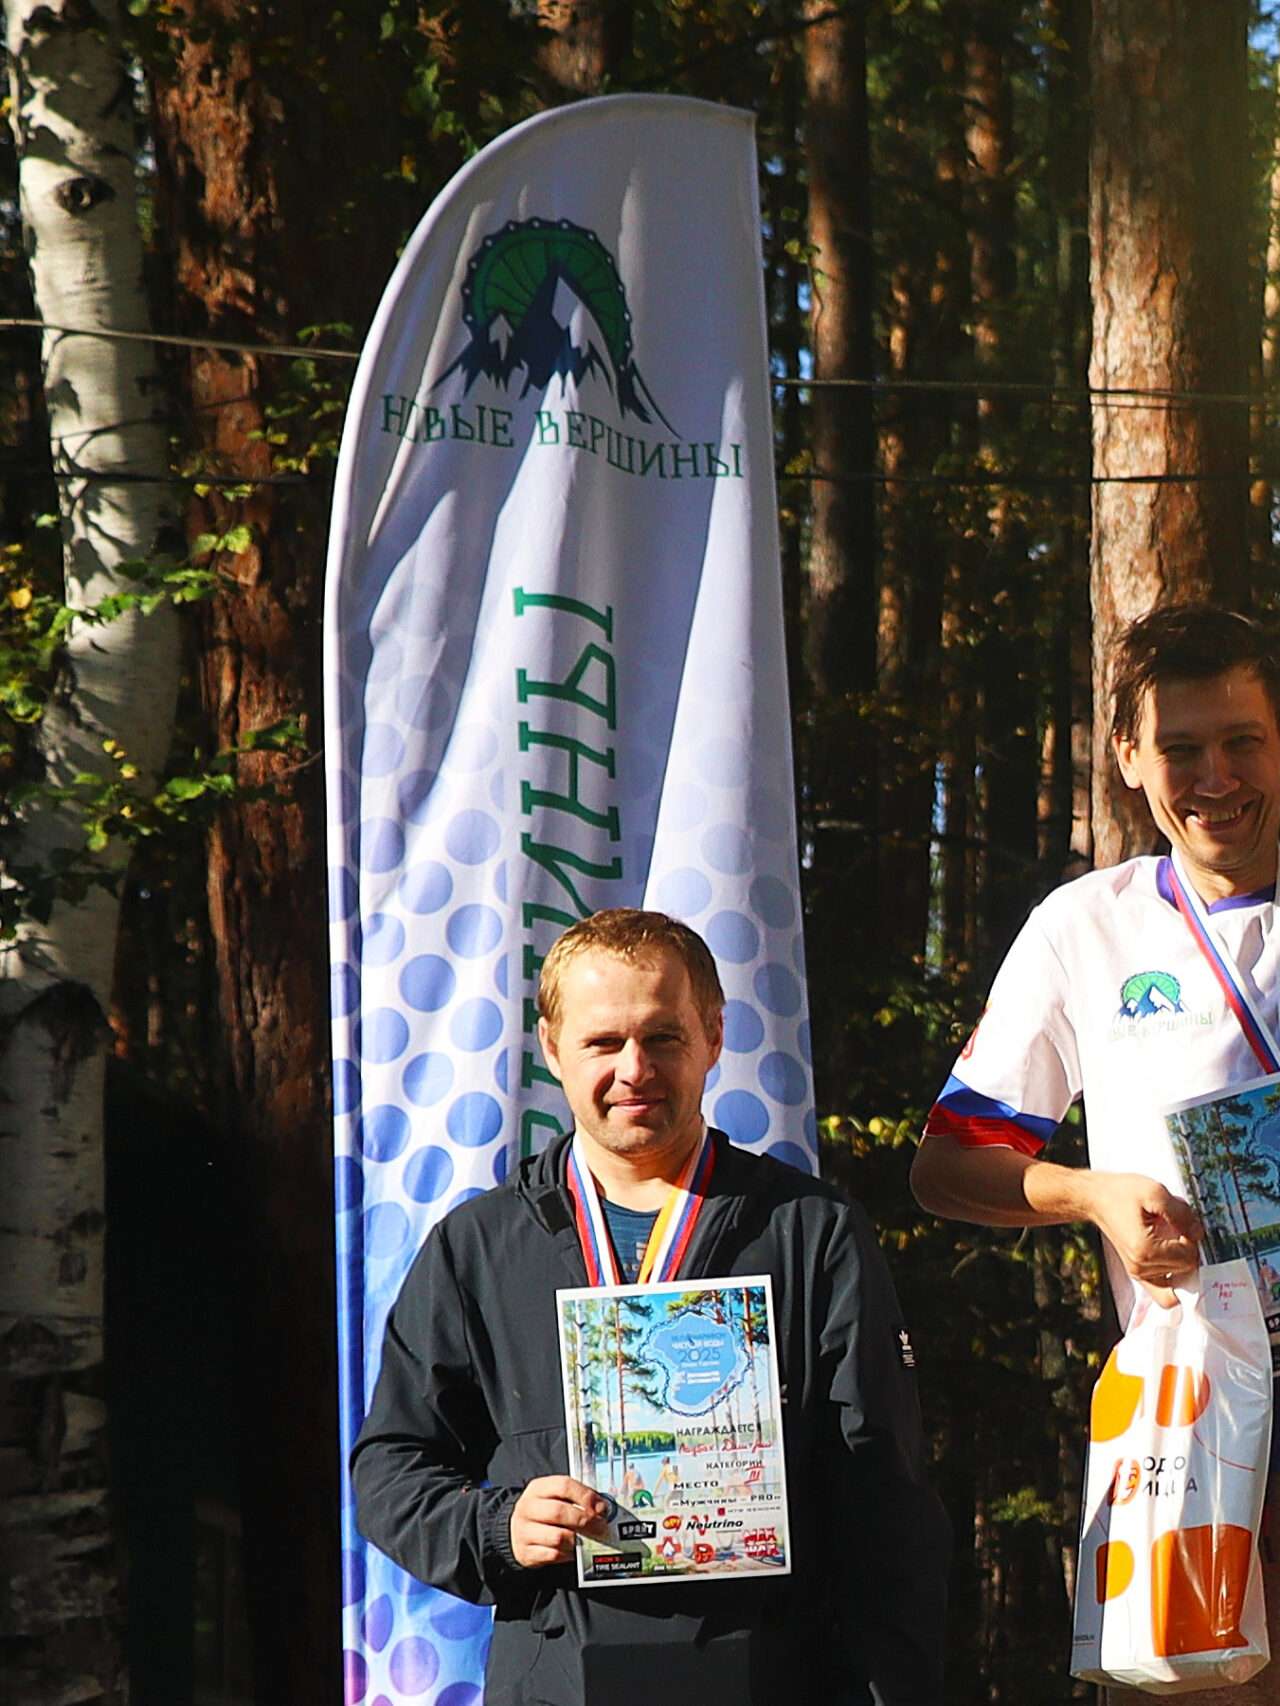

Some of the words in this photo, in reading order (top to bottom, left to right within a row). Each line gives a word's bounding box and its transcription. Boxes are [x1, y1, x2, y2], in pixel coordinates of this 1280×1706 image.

[380, 394, 514, 447] НОВЫЕ
[536, 410, 744, 479] ВЕРШИНЫ
[676, 1422, 762, 1437] НАГРАЖДАЕТС
[706, 1459, 763, 1471] КАТЕГОРИИ
[673, 1480, 719, 1490] МЕСТО
[686, 1519, 744, 1531] Neutrino
